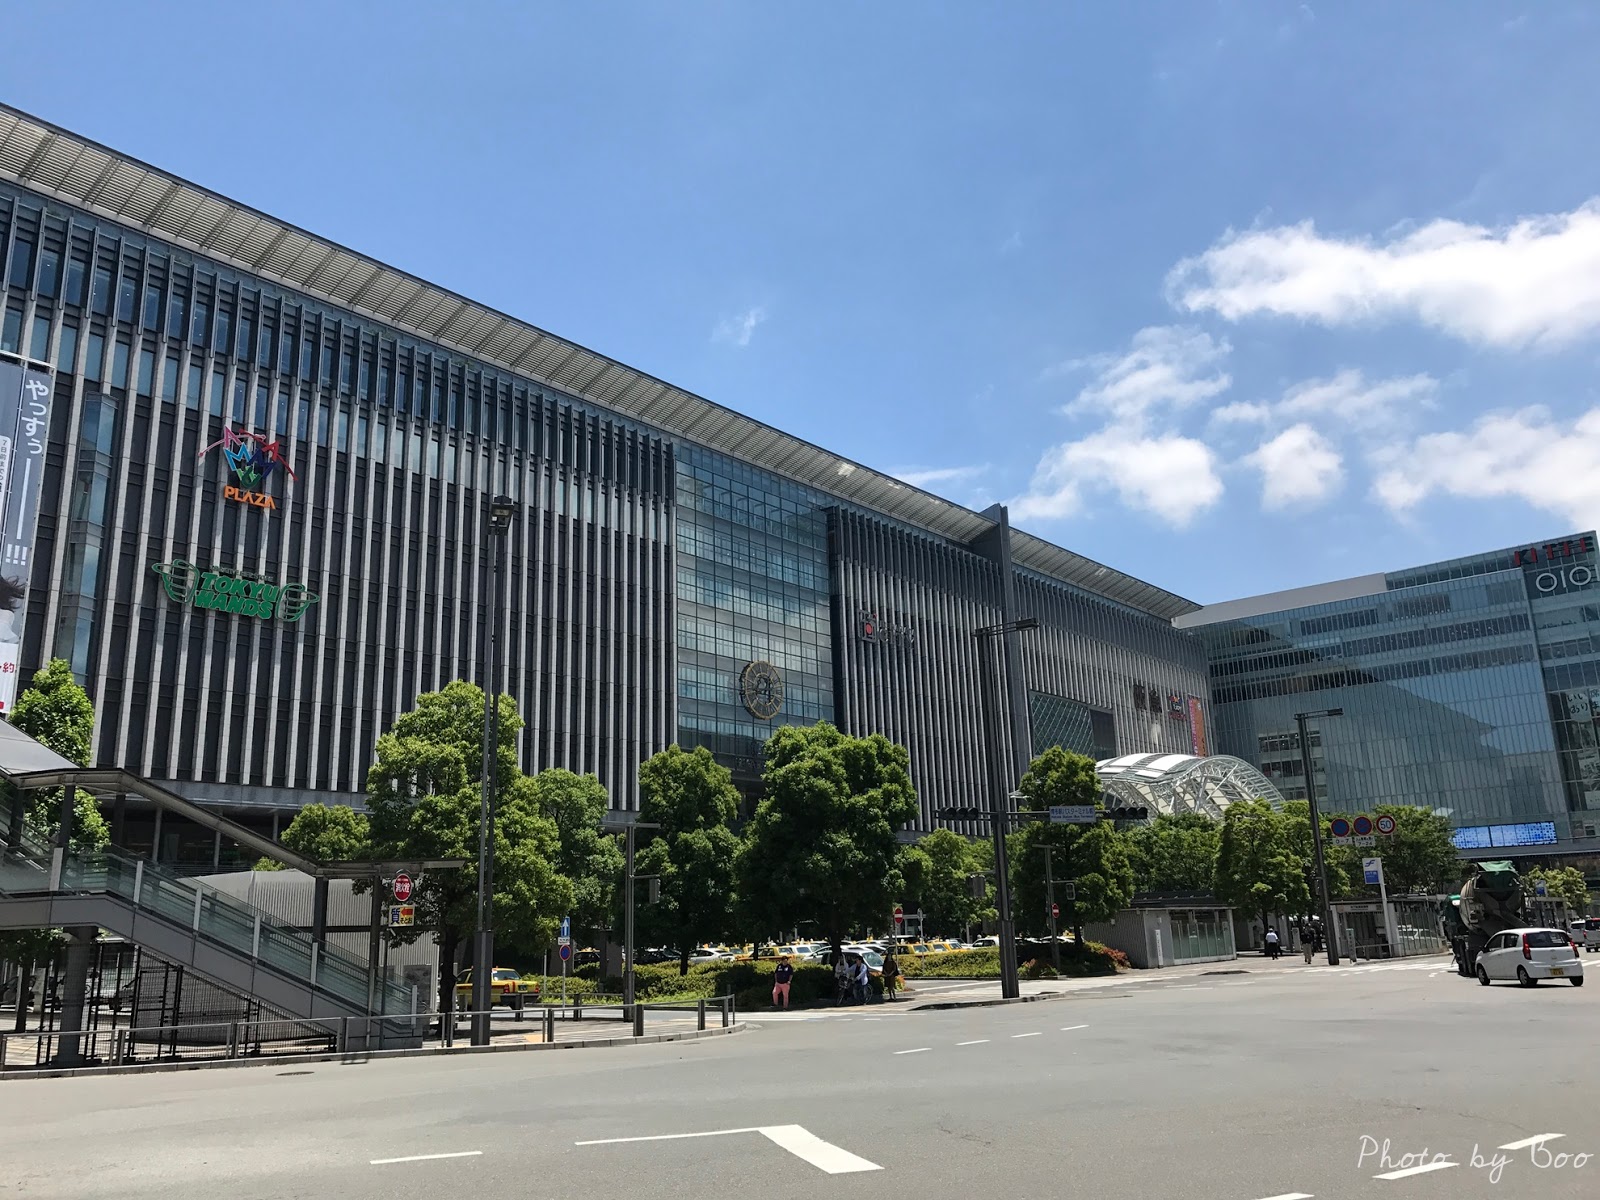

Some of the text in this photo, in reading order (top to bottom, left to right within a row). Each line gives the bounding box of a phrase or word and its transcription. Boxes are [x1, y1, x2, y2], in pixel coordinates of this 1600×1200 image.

[223, 485, 276, 510] PLAZA
[1514, 536, 1595, 567] KITTE
[201, 572, 280, 602] TOKYU
[195, 590, 274, 620] HANDS
[1380, 820, 1391, 829] 50
